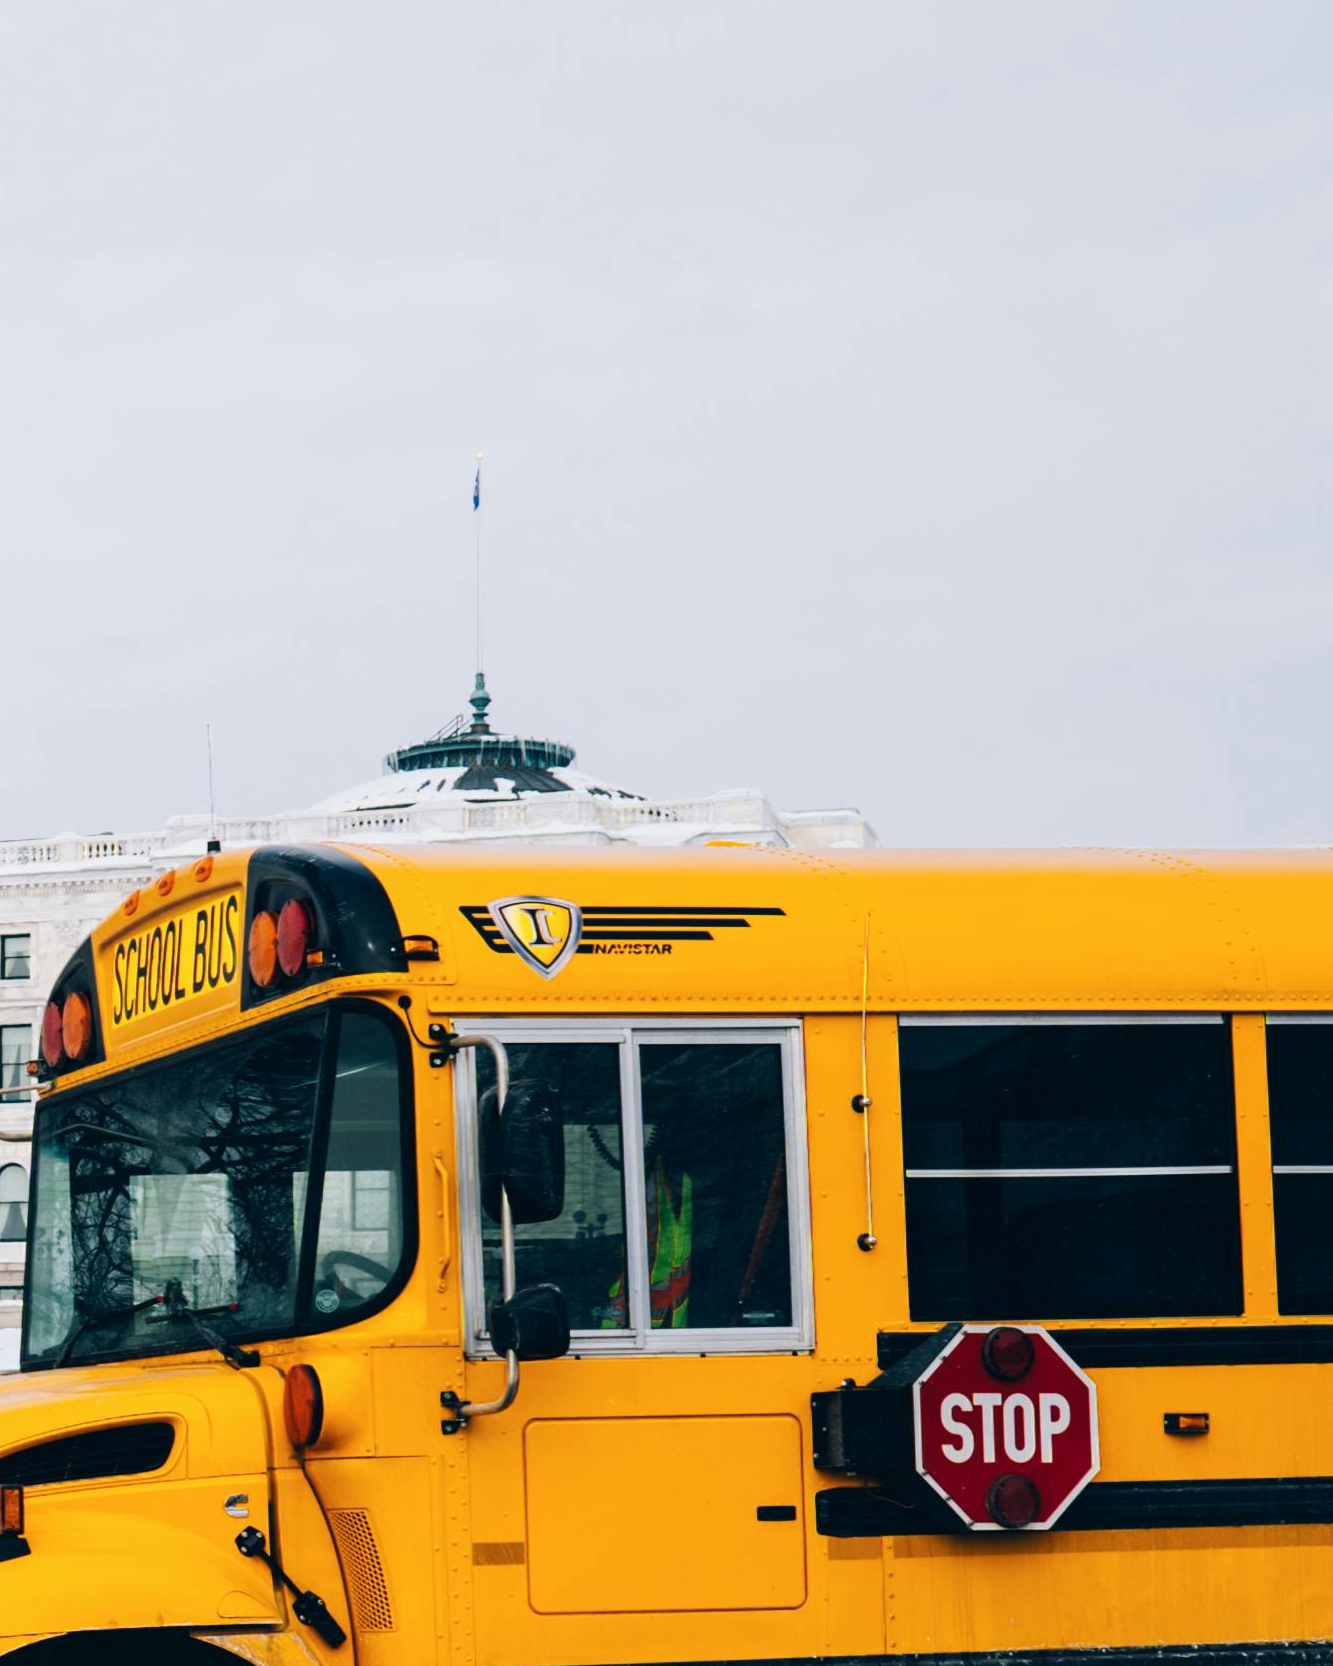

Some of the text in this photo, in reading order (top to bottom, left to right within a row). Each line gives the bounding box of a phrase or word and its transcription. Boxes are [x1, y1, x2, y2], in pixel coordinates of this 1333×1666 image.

[113, 894, 238, 1026] SCHOOL BUS
[594, 943, 673, 955] NAVISTAR
[940, 1392, 1071, 1464] STOP
